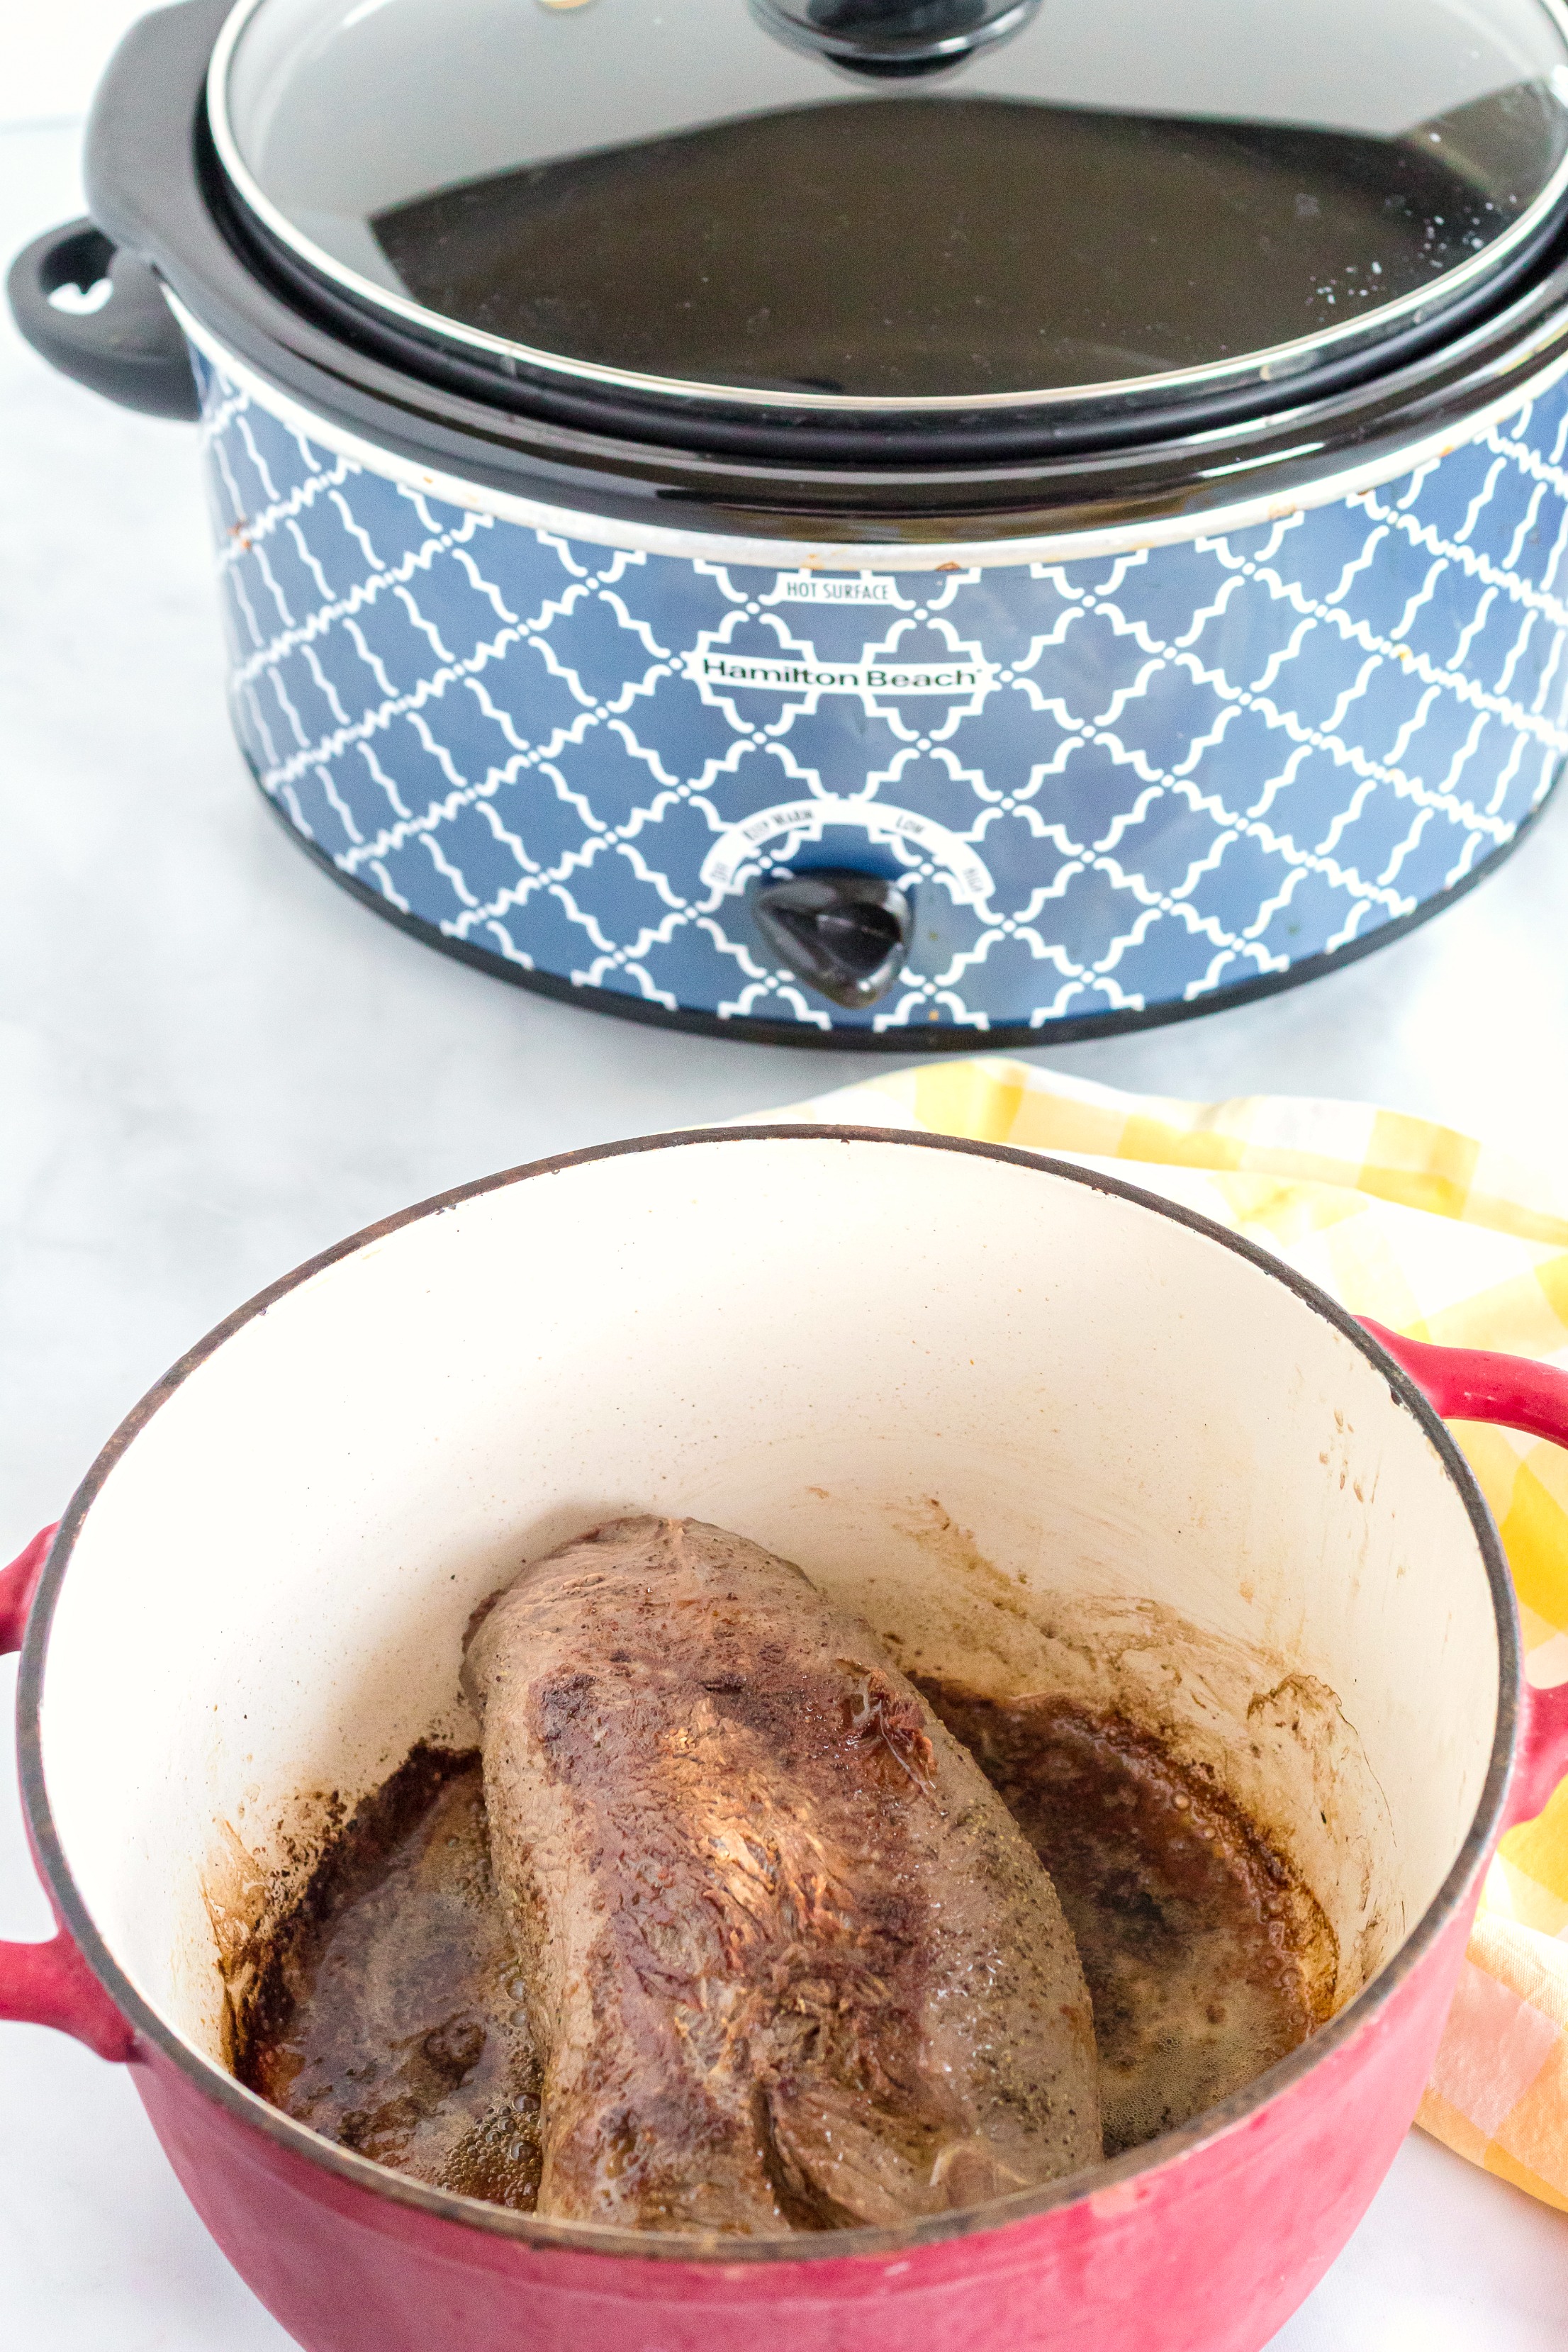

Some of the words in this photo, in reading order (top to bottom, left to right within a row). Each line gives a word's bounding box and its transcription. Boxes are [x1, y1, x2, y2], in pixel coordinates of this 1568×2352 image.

[787, 581, 817, 598] HOT
[823, 583, 888, 600] SURFACE
[703, 659, 858, 686] Hamilton
[866, 669, 975, 687] Beach
